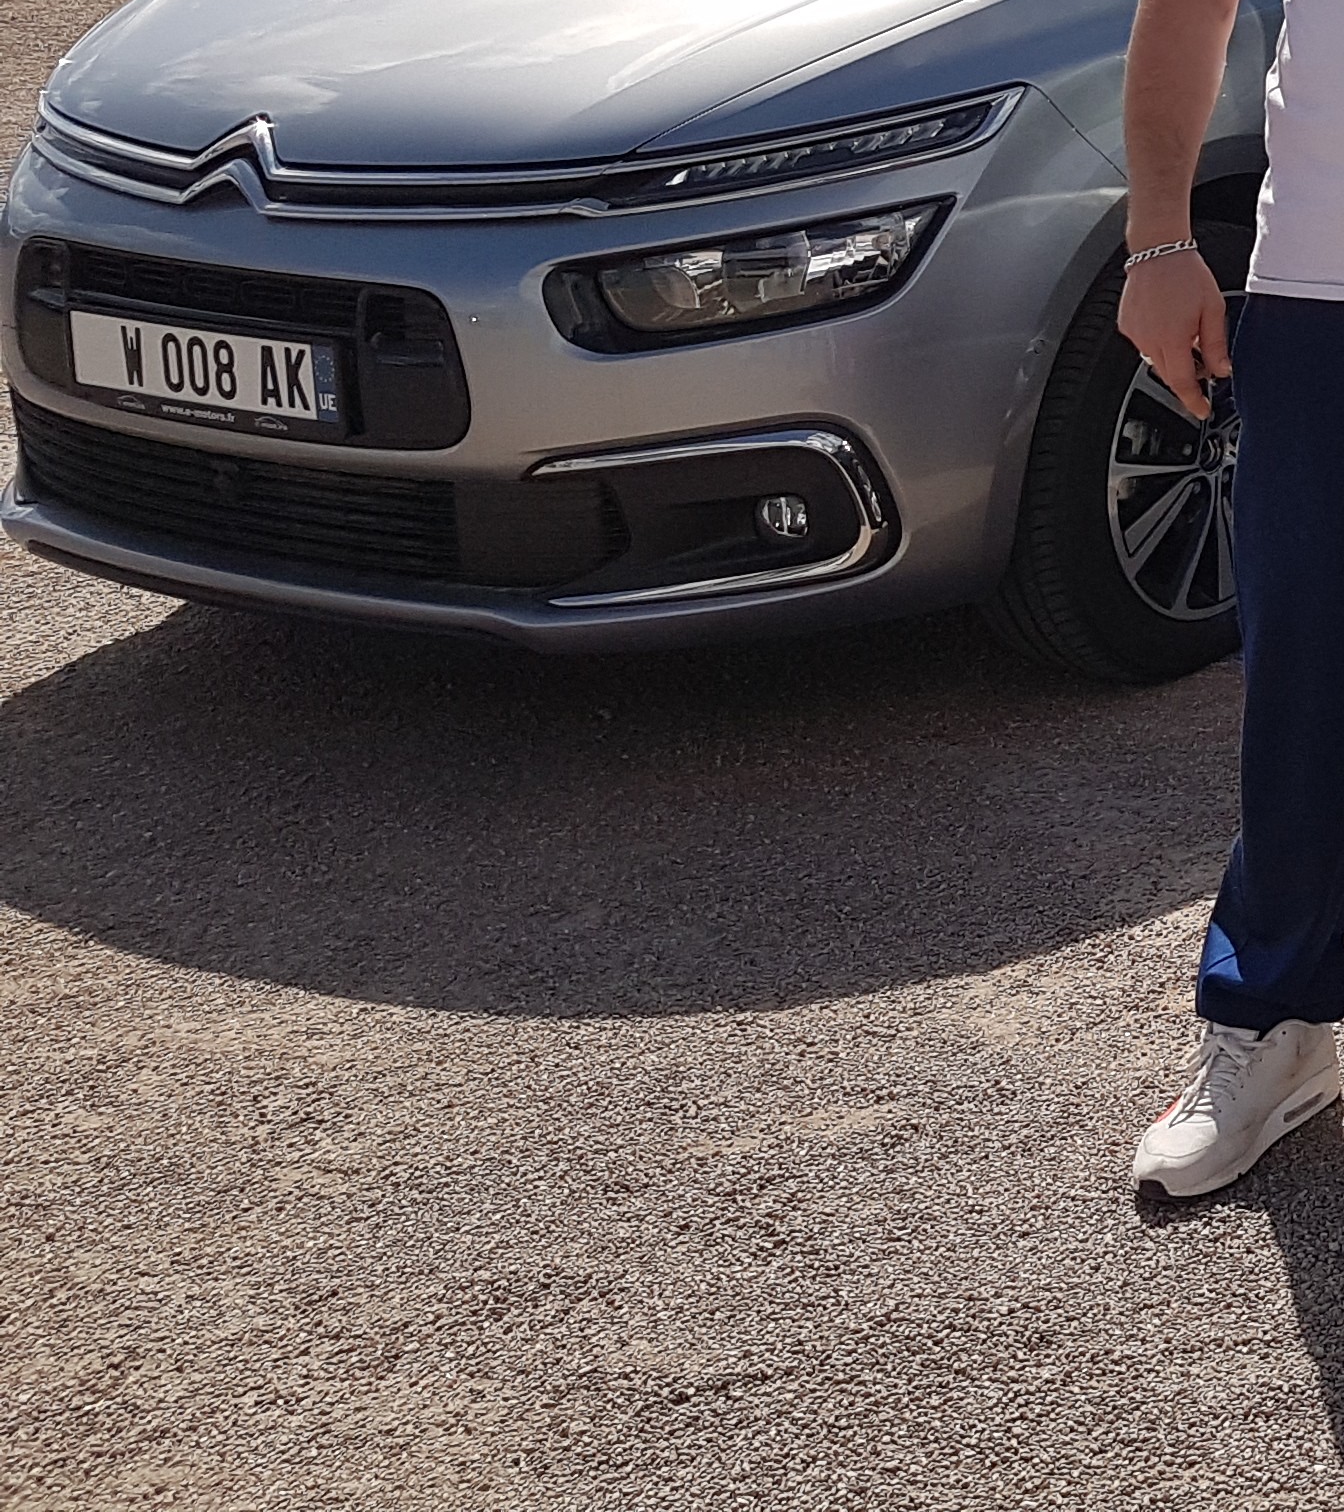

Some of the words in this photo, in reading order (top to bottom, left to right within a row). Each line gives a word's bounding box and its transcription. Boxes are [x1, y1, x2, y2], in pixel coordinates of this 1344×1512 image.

[120, 325, 144, 387] W
[161, 332, 237, 401] 008
[260, 345, 311, 412] AK
[318, 393, 338, 413] UE
